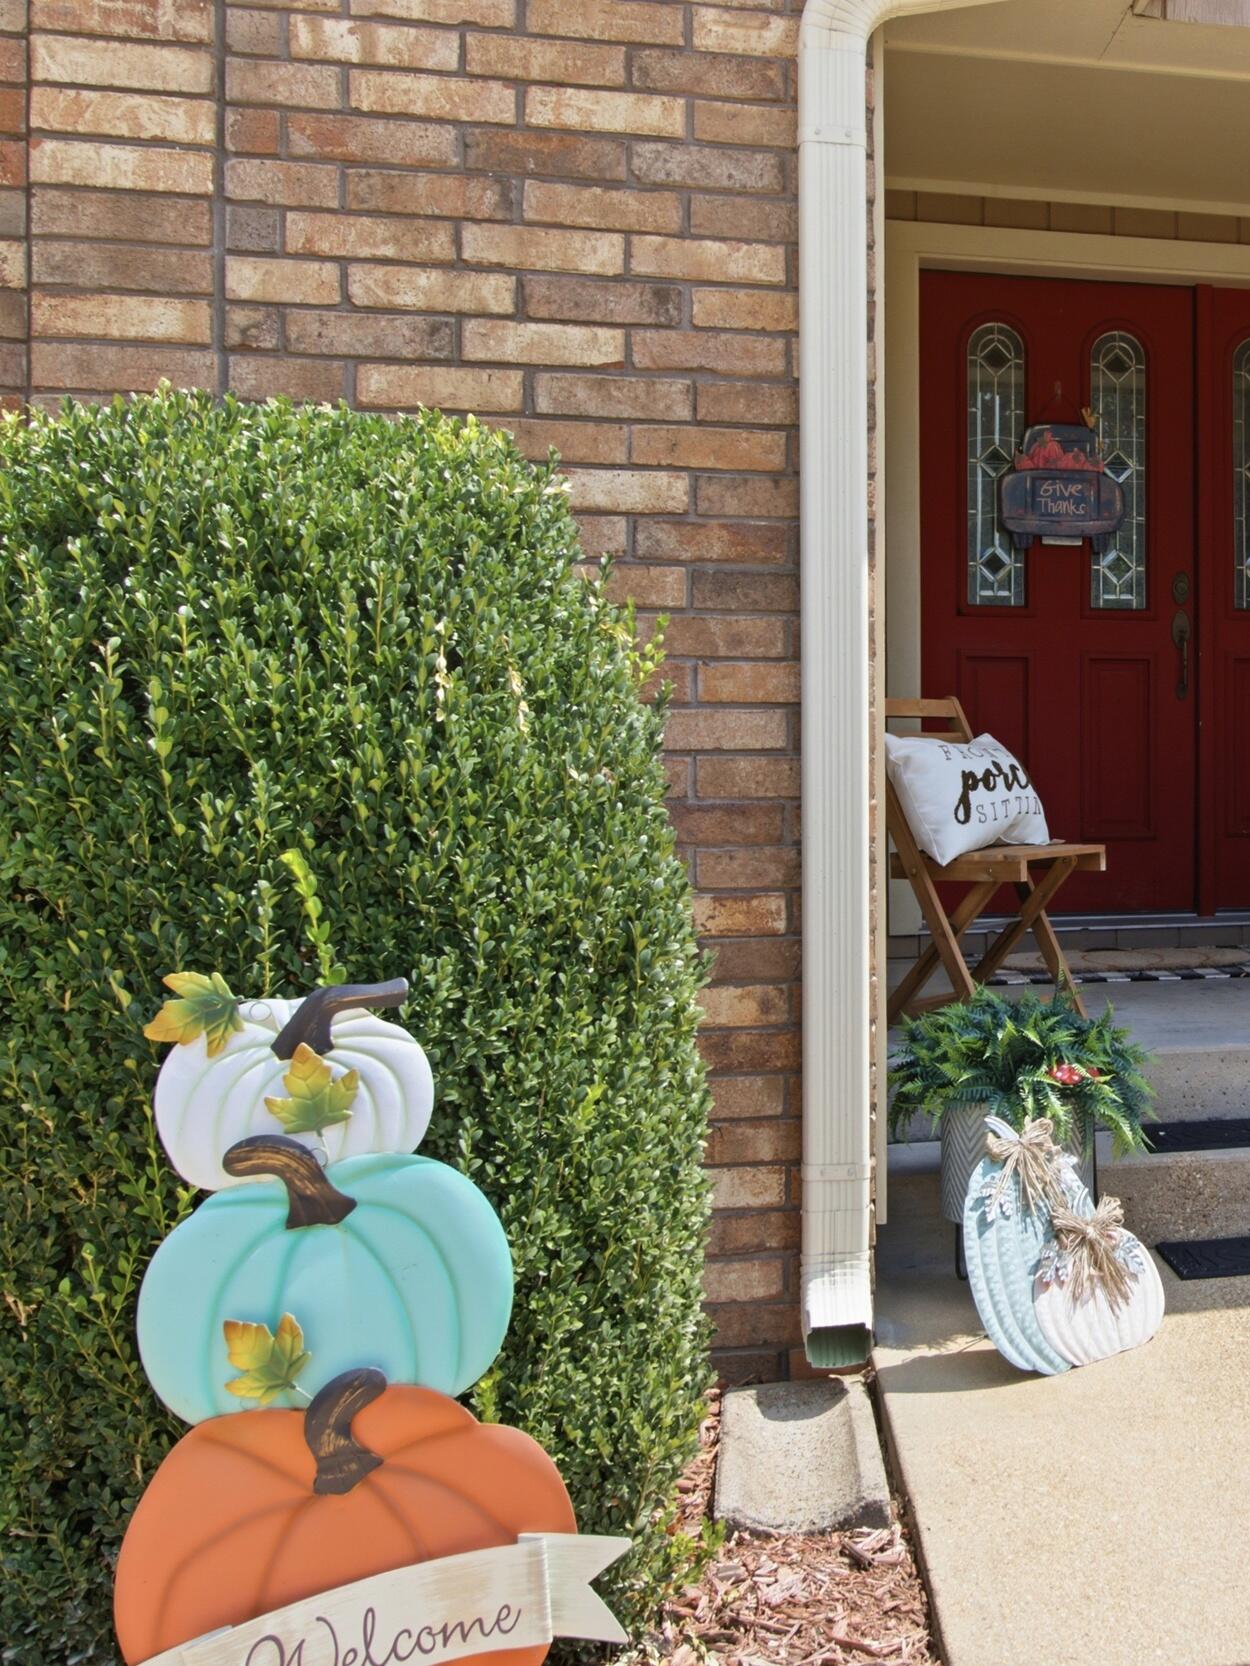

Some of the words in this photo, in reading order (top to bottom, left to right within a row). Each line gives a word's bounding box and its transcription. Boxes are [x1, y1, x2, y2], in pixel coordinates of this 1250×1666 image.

[1036, 498, 1087, 515] Thanks
[1040, 480, 1082, 497] Give
[954, 760, 1030, 825] porc
[245, 1604, 522, 1666] Welcome
